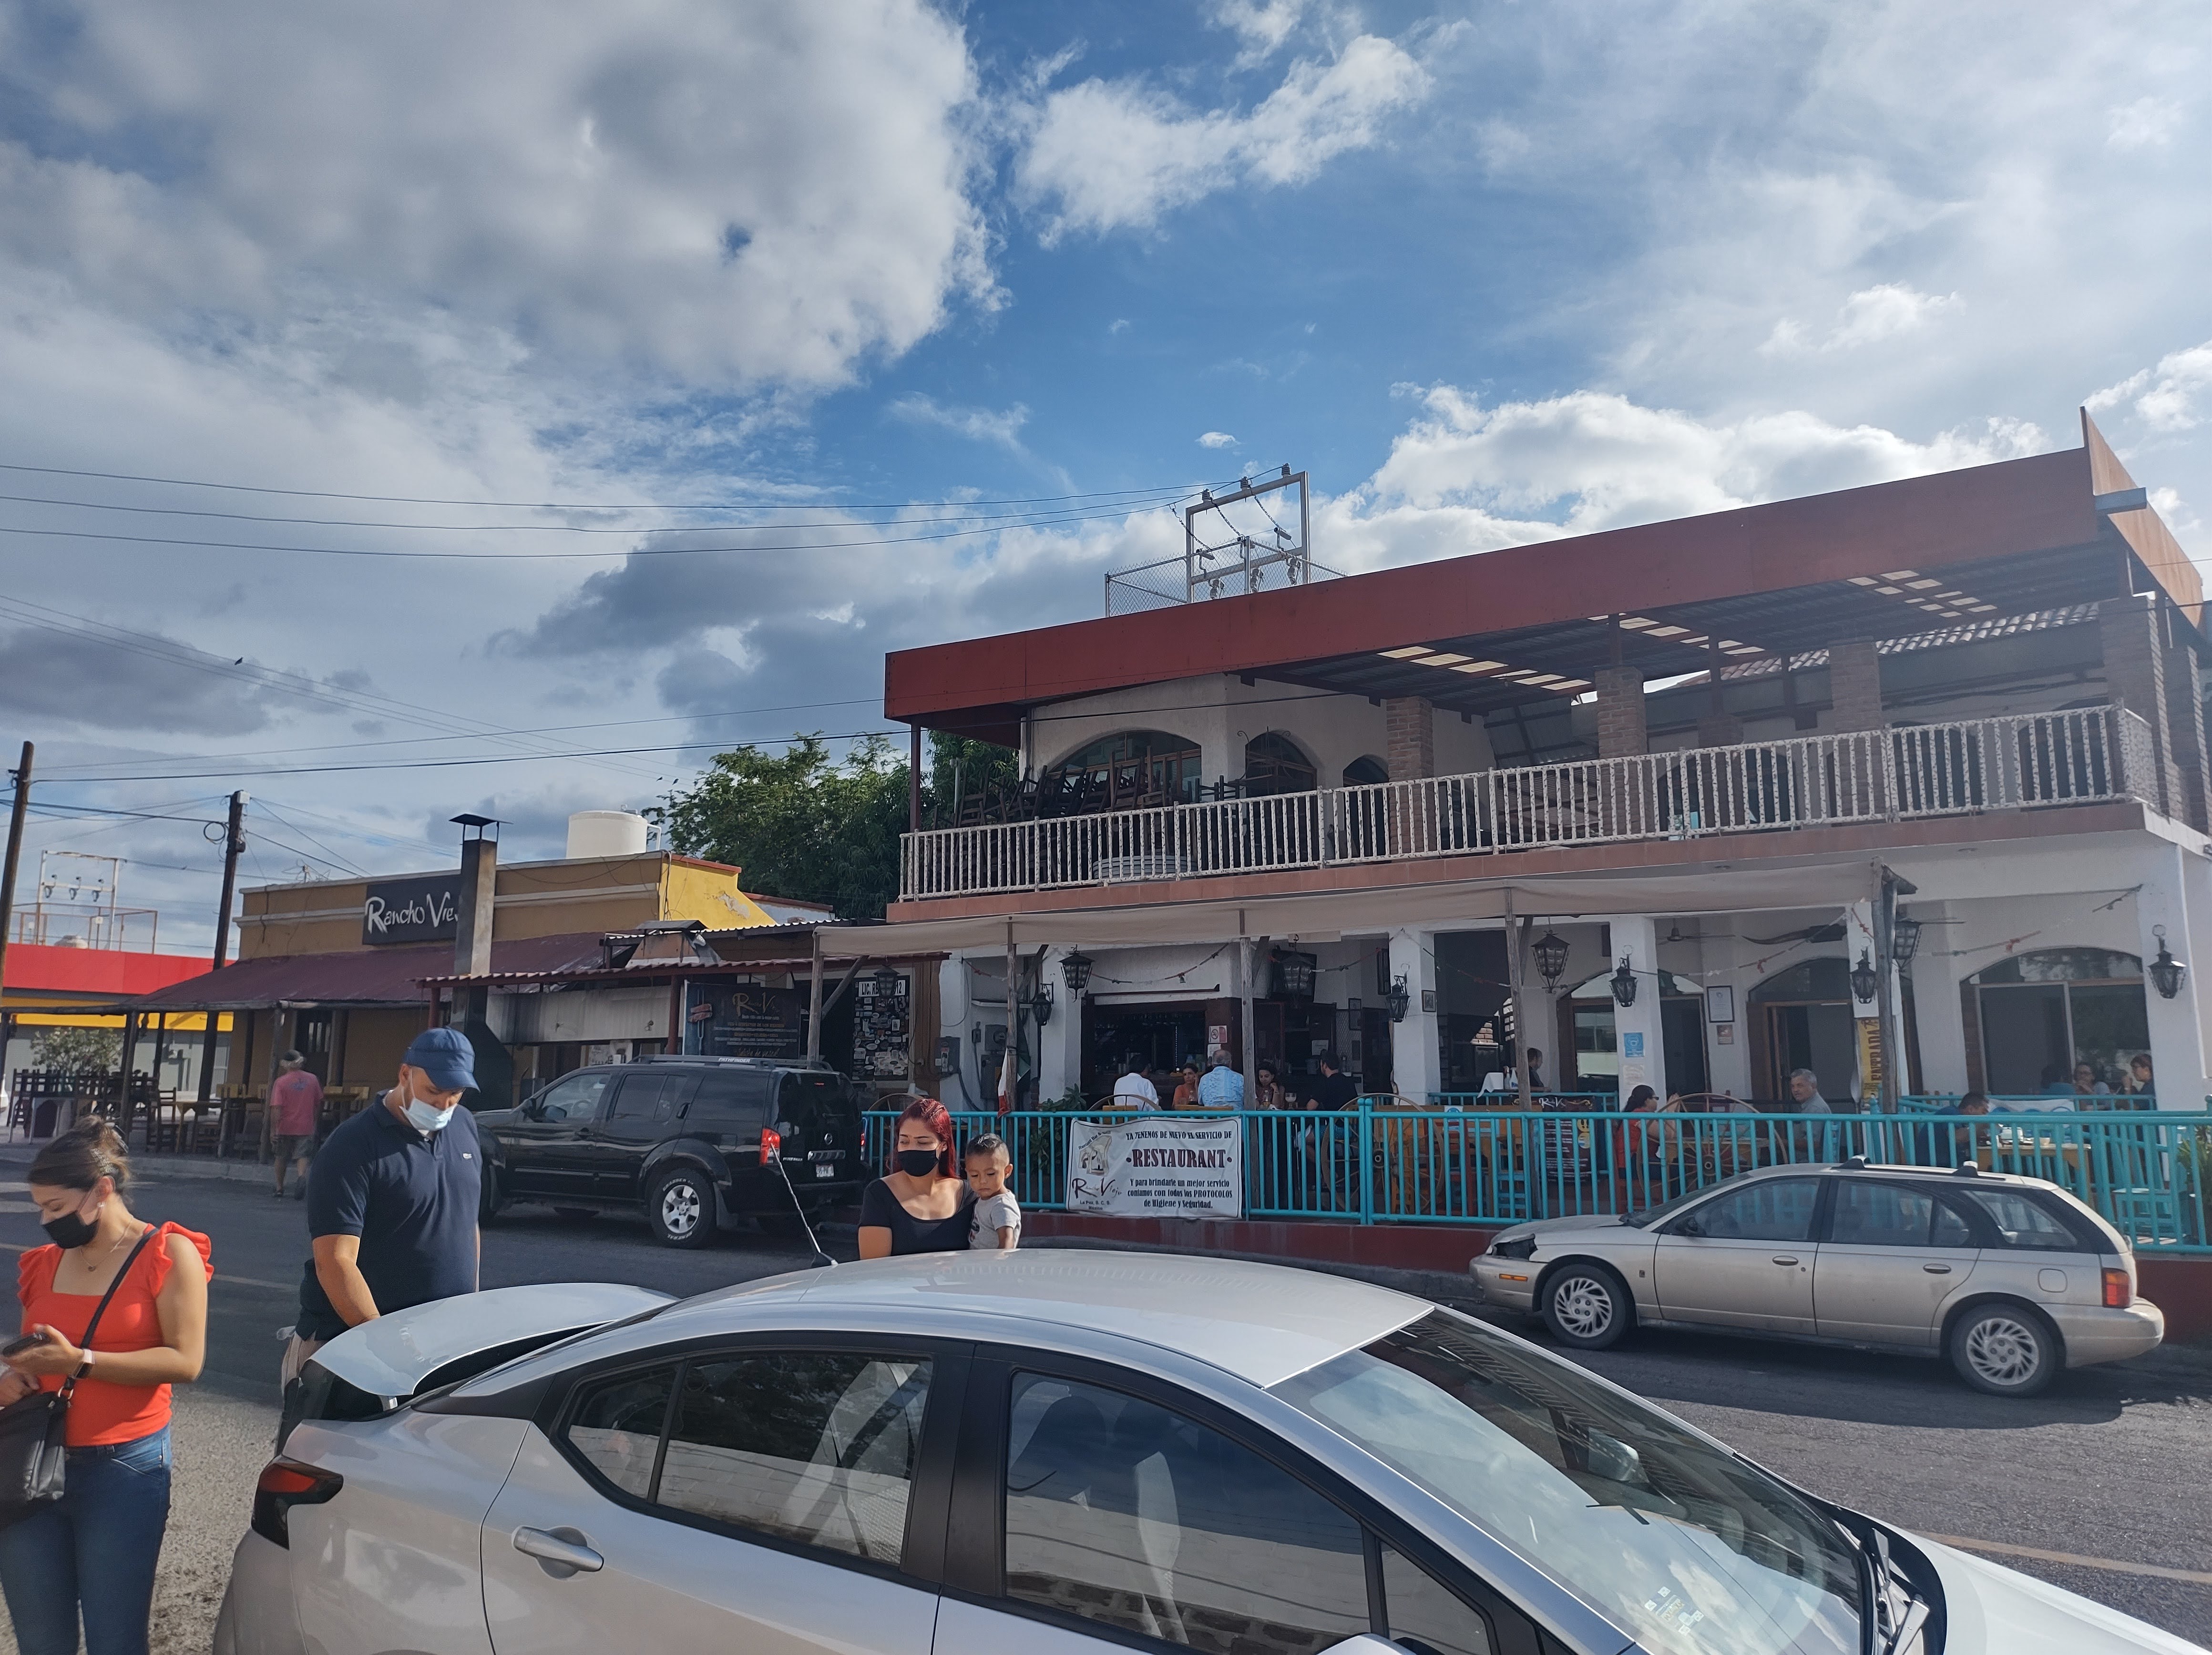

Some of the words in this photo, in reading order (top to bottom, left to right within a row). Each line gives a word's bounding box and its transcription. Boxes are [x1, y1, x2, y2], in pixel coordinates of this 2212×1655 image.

[365, 896, 425, 934] Rancho
[426, 891, 459, 928] Vie
[862, 983, 871, 995] LIC.
[1135, 1131, 1158, 1139] TENEMOS
[1160, 1131, 1167, 1139] DE
[1169, 1131, 1186, 1139] NUEVO
[1195, 1131, 1222, 1139] SERVICIO
[1224, 1131, 1232, 1139] DE
[1132, 1148, 1226, 1168] RESTAURANT
[1130, 1178, 1134, 1186] Y
[1135, 1179, 1147, 1187] para
[1148, 1178, 1177, 1186] brindarle
[1187, 1179, 1205, 1188] mejor
[1207, 1179, 1230, 1187] servicio
[1127, 1189, 1153, 1197] contamos
[1167, 1189, 1183, 1197] todos
[1184, 1189, 1192, 1197] los
[1194, 1190, 1233, 1198] PROTOCOLOS
[1144, 1199, 1151, 1207] de
[1152, 1199, 1177, 1208] Higiene
[1178, 1200, 1181, 1209] y
[1182, 1199, 1213, 1209] Seguridad.
